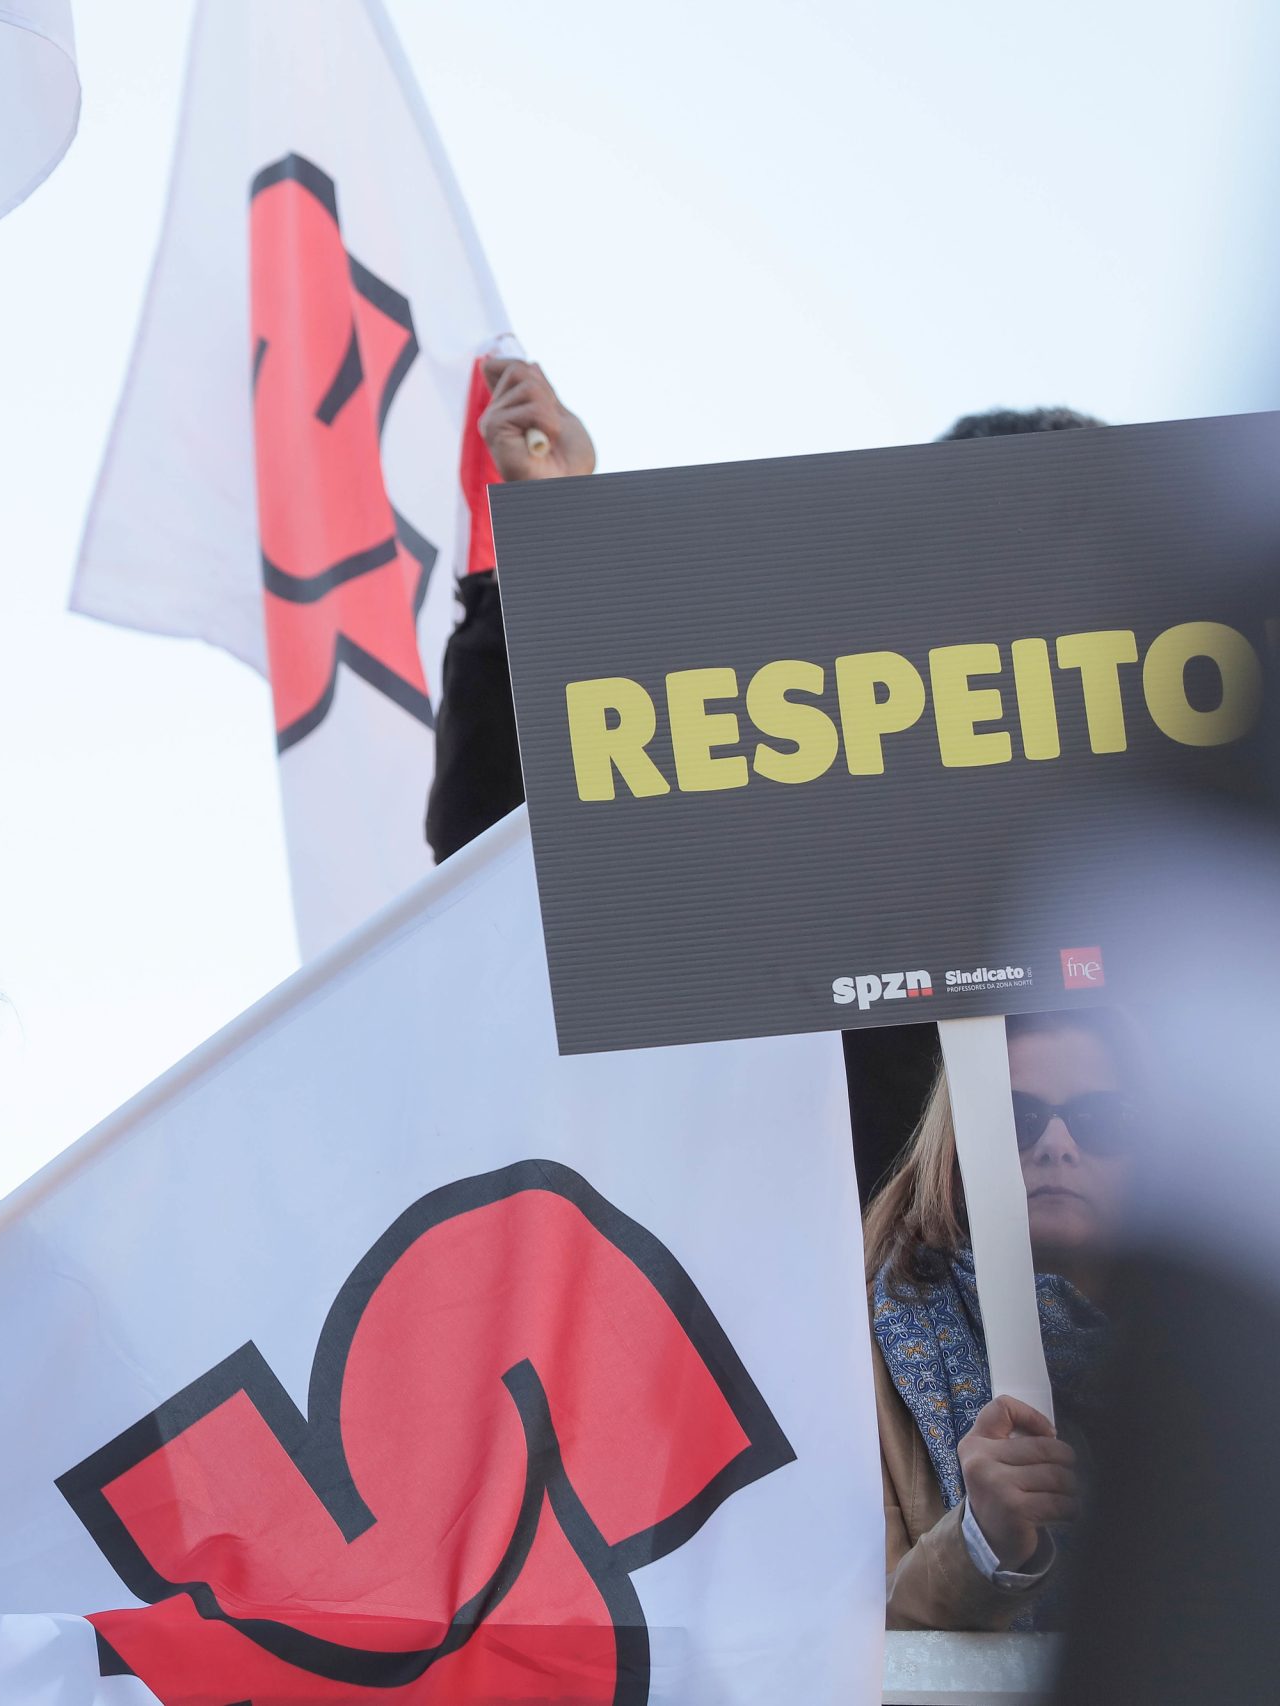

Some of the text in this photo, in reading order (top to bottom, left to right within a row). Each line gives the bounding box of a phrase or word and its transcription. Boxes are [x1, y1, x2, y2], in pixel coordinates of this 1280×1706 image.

[565, 621, 1264, 801] RESPEITO
[945, 966, 1024, 985] Sindicato
[1067, 956, 1102, 981] fne
[831, 969, 933, 1011] spzn
[946, 983, 986, 993] PROFESSORES
